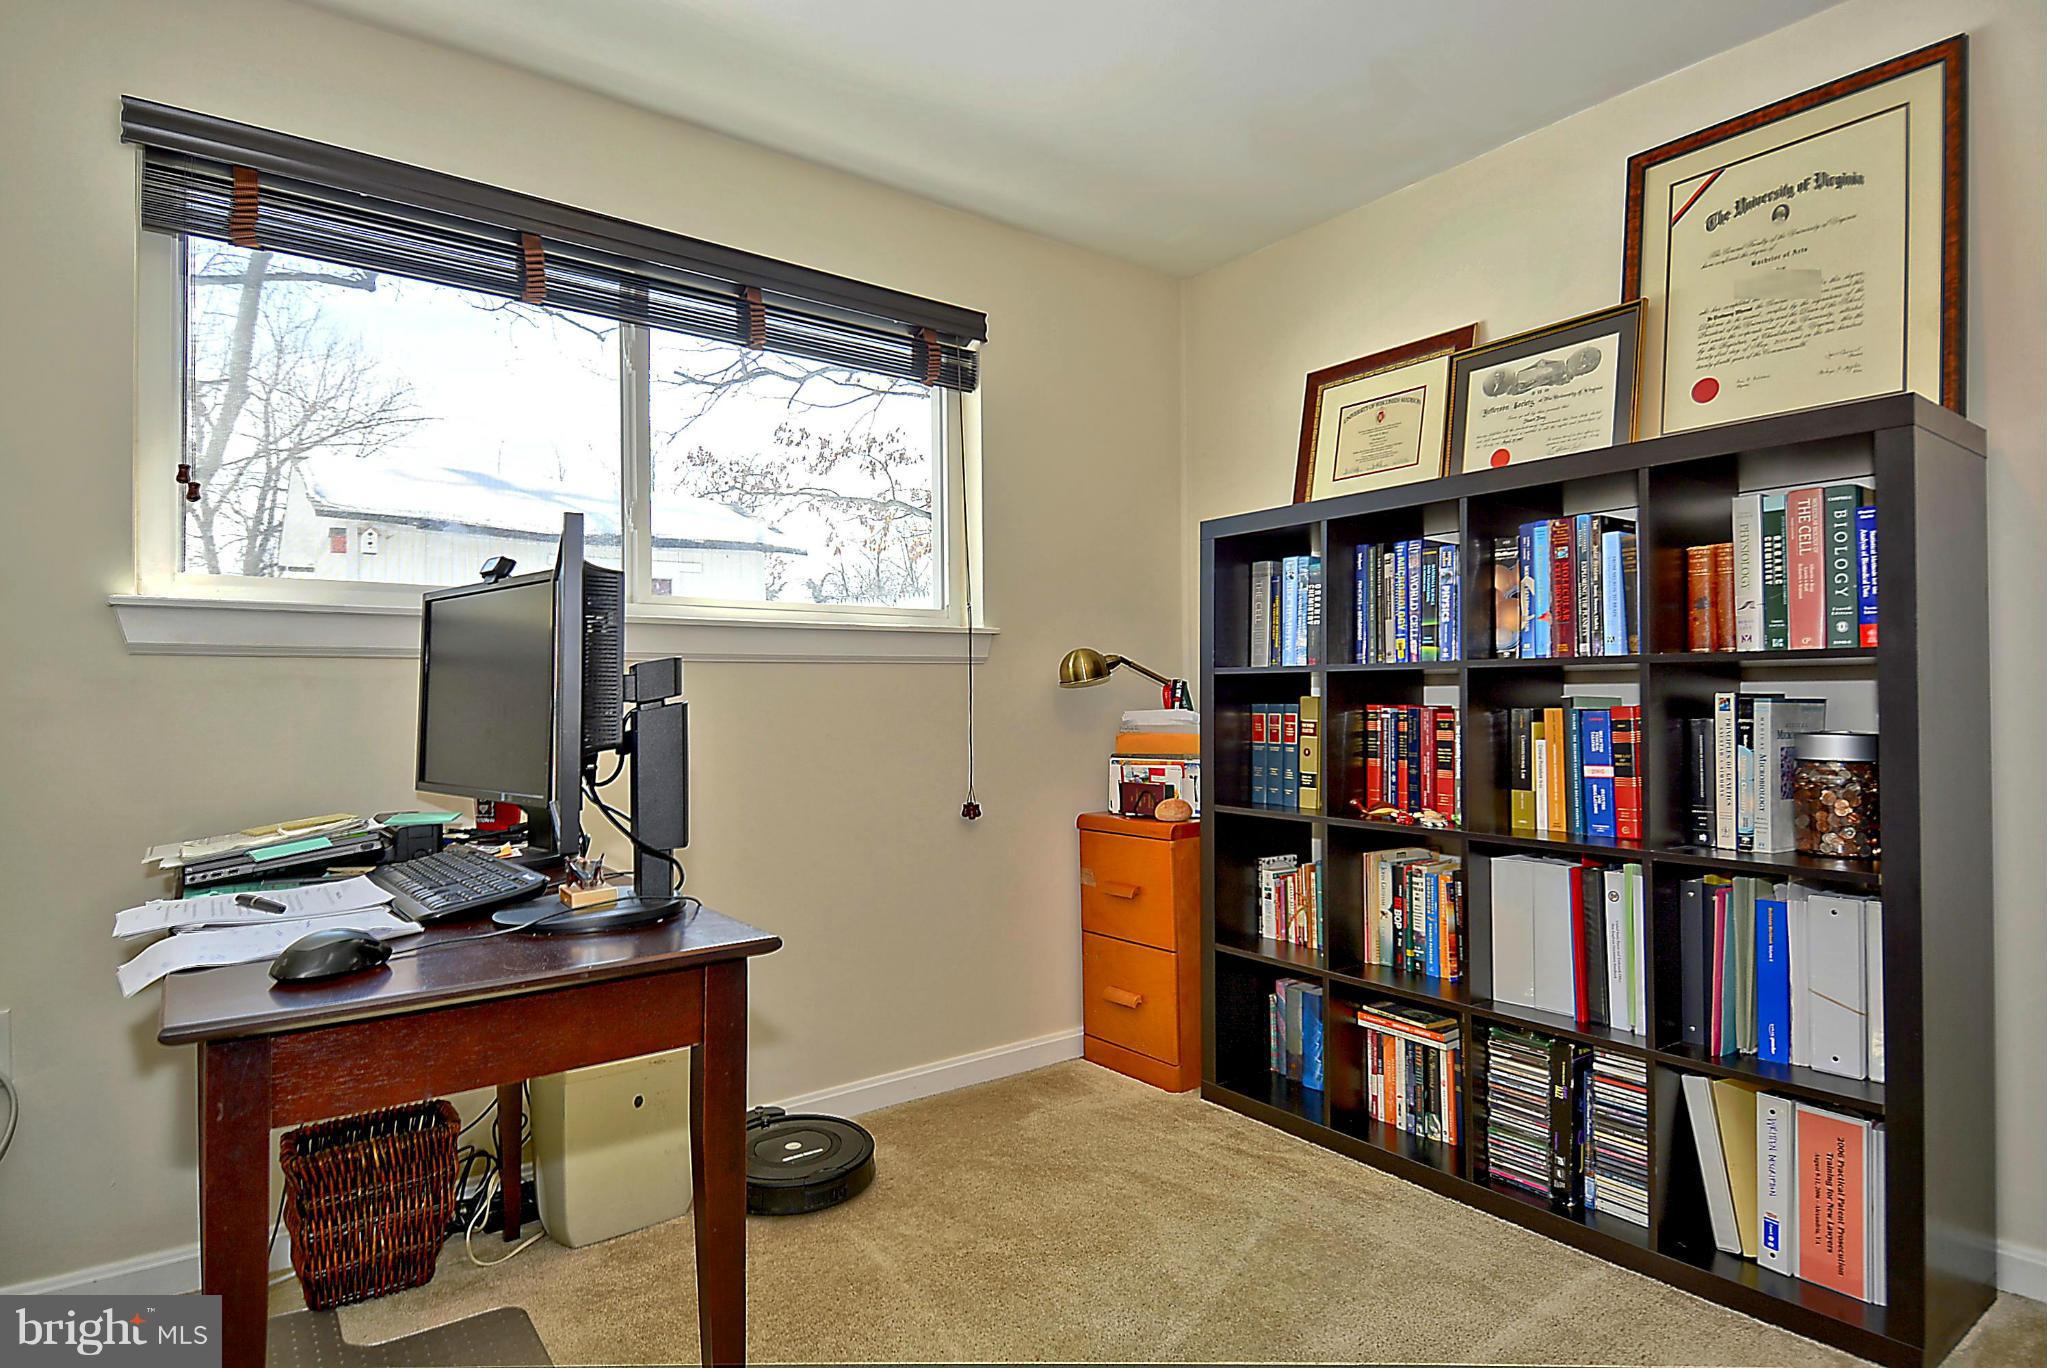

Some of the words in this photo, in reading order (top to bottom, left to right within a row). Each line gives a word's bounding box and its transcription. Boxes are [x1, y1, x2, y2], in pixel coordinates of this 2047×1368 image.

[1705, 209, 1731, 232] The
[1734, 184, 1796, 218] University
[1797, 177, 1812, 193] of
[1814, 171, 1865, 189] Virginia
[1792, 246, 1809, 256] Arts
[1798, 498, 1811, 524] THE
[1740, 523, 1750, 590] PHYSIOLOGY
[1798, 525, 1812, 556] CELL
[1832, 509, 1848, 597] BIOLOGY
[1554, 561, 1562, 581] CELL
[1580, 560, 1588, 597] EXPLORING
[1764, 537, 1772, 586] CHEMISTRY
[1773, 535, 1782, 585] ORGANIC
[1255, 582, 1264, 599] THE
[1307, 584, 1315, 625] CHEMISTRY
[1313, 583, 1322, 625] ORGANIC
[1397, 556, 1406, 630] MICROBIOLOGY
[1410, 575, 1419, 611] WORLD
[1441, 585, 1451, 623] PHYSICS
[1554, 583, 1562, 621] BIOLOGY
[1562, 561, 1570, 621] MOLECULAR
[1254, 601, 1263, 625] CELL
[1410, 615, 1419, 641] CELL
[1726, 761, 1732, 769] OF
[1758, 754, 1768, 812] MICROBIOLOGY
[1825, 1153, 1834, 1187] Training
[1837, 1159, 1845, 1197] Practical
[1826, 1188, 1834, 1200] for
[1825, 1220, 1834, 1253] Lawyers
[1837, 1227, 1845, 1276] Prosecution
